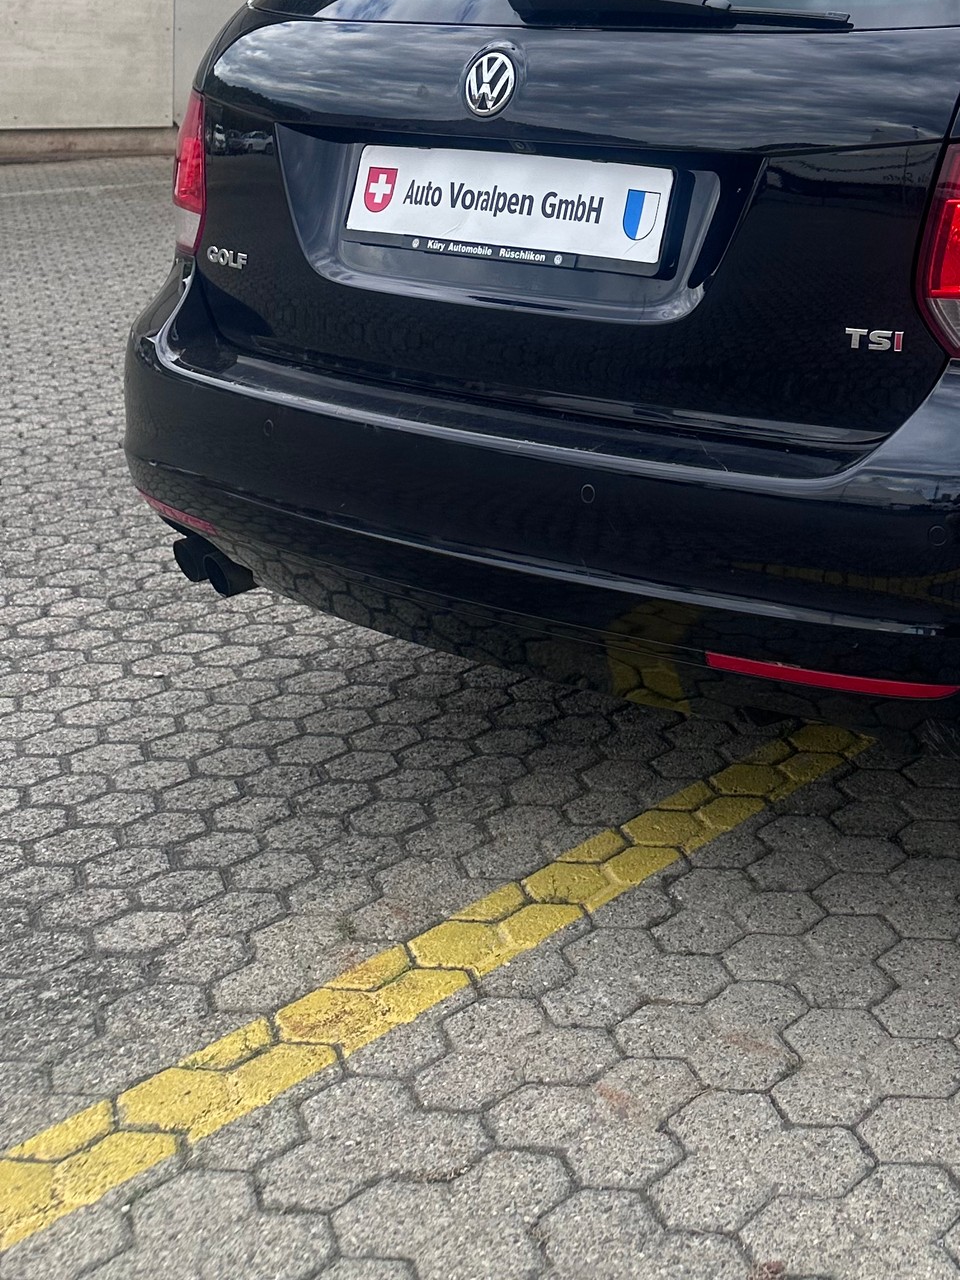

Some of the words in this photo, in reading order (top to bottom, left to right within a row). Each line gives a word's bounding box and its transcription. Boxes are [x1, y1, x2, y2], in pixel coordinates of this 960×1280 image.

[403, 179, 442, 208] Auto
[450, 181, 534, 217] Voralpen
[541, 191, 604, 224] GmbH
[207, 246, 248, 270] GOLF
[448, 242, 492, 256] Automobile
[499, 248, 546, 262] Rüschlikon
[845, 327, 904, 352] TSI
